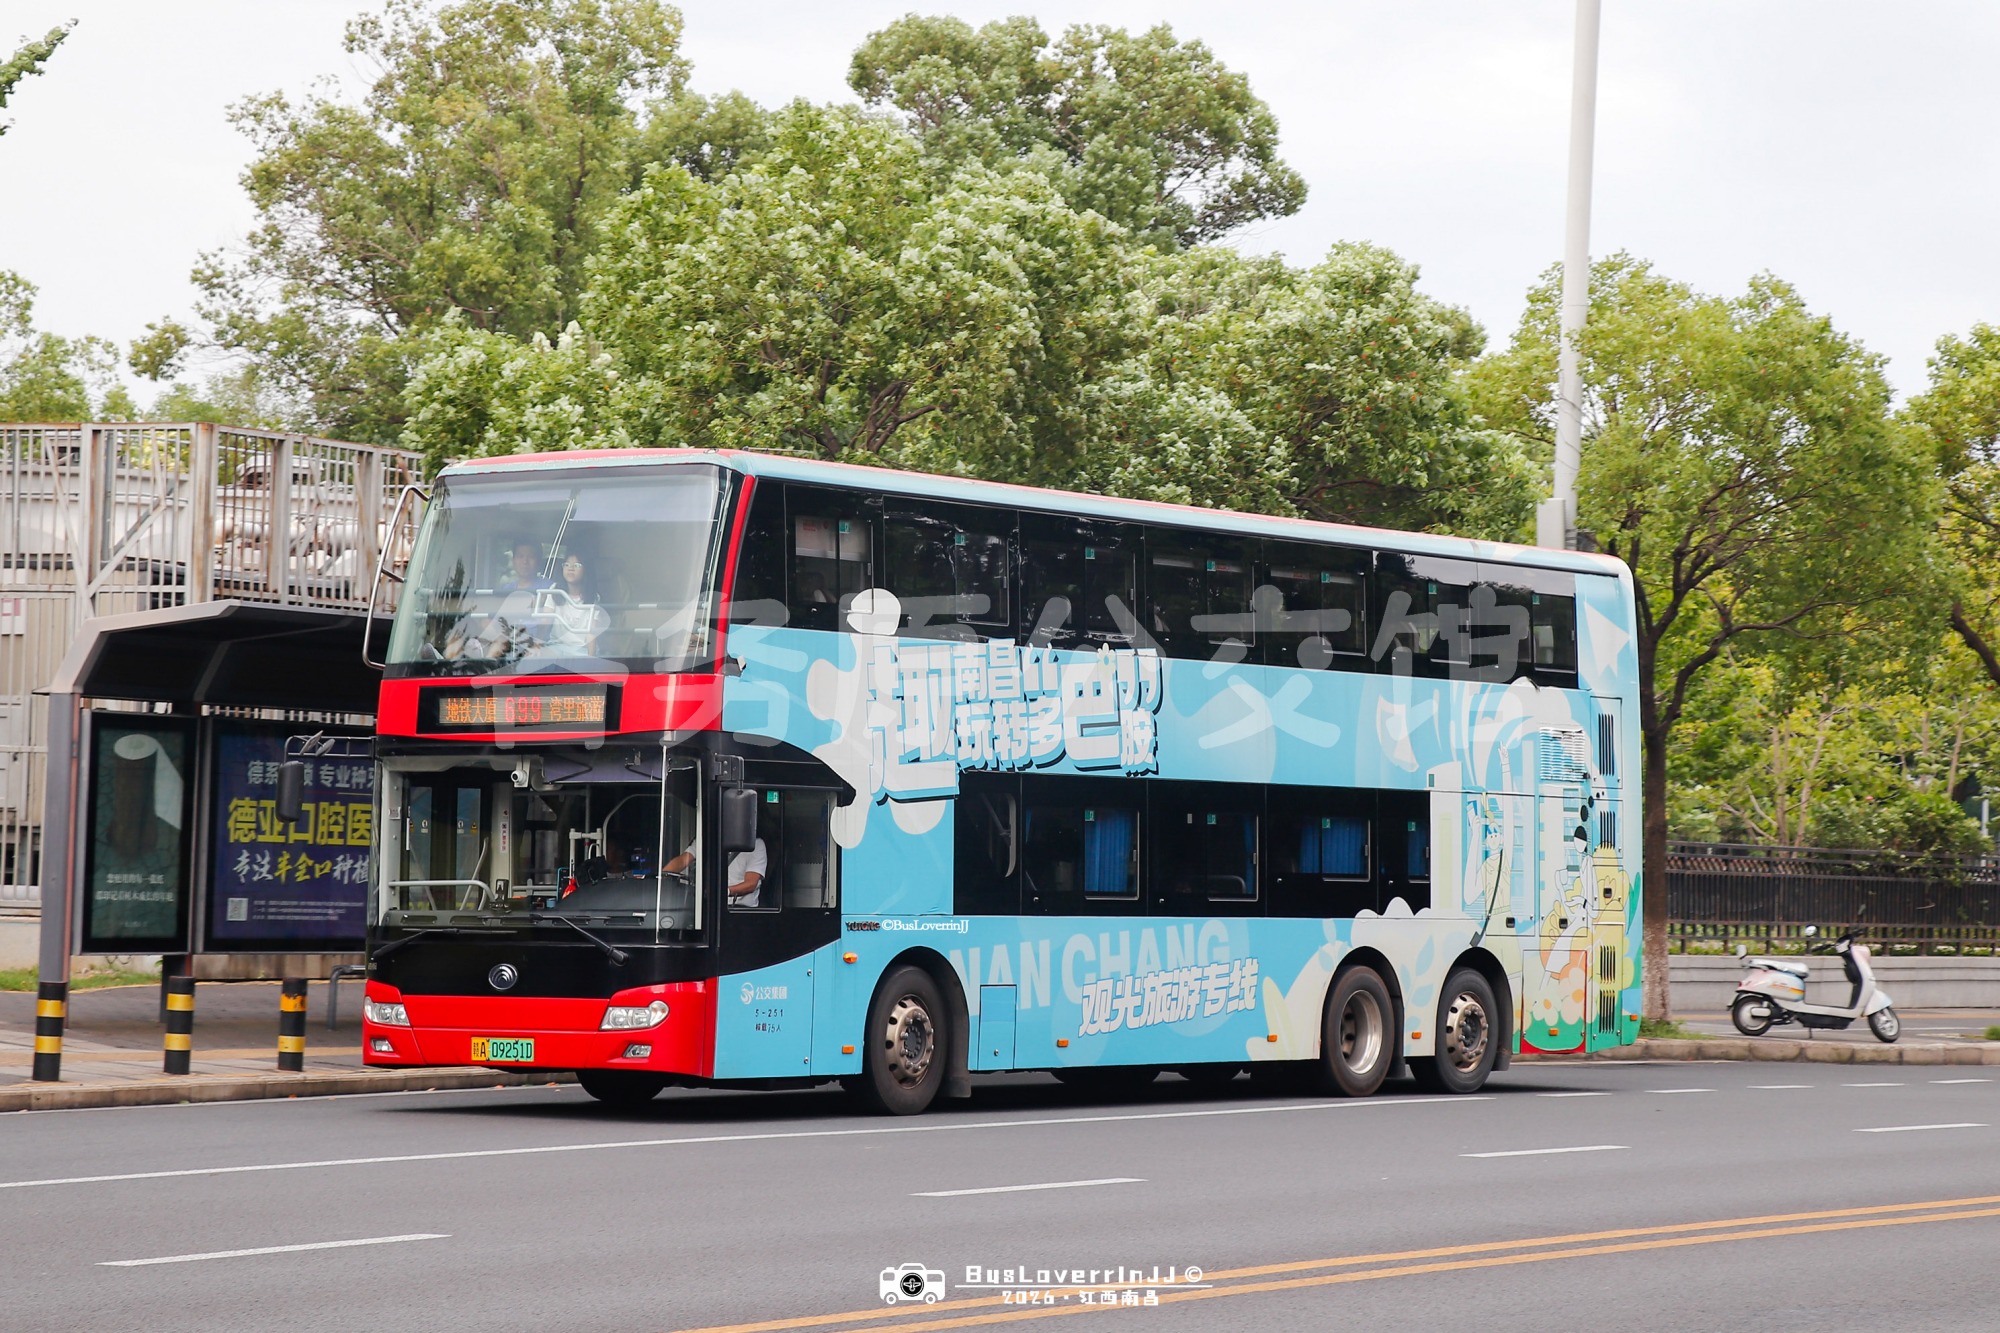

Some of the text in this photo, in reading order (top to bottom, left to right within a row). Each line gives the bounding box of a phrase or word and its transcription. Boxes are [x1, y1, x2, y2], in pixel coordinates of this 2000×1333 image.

[446, 697, 497, 723] 地铁大厦
[505, 696, 542, 723] 699
[248, 760, 314, 787] 德系锁
[227, 797, 374, 846] 德亚口腔医
[1061, 920, 1231, 1005] CHANG
[755, 986, 788, 1000] 公交集团
[1078, 957, 1259, 1038] 观光旅游专线
